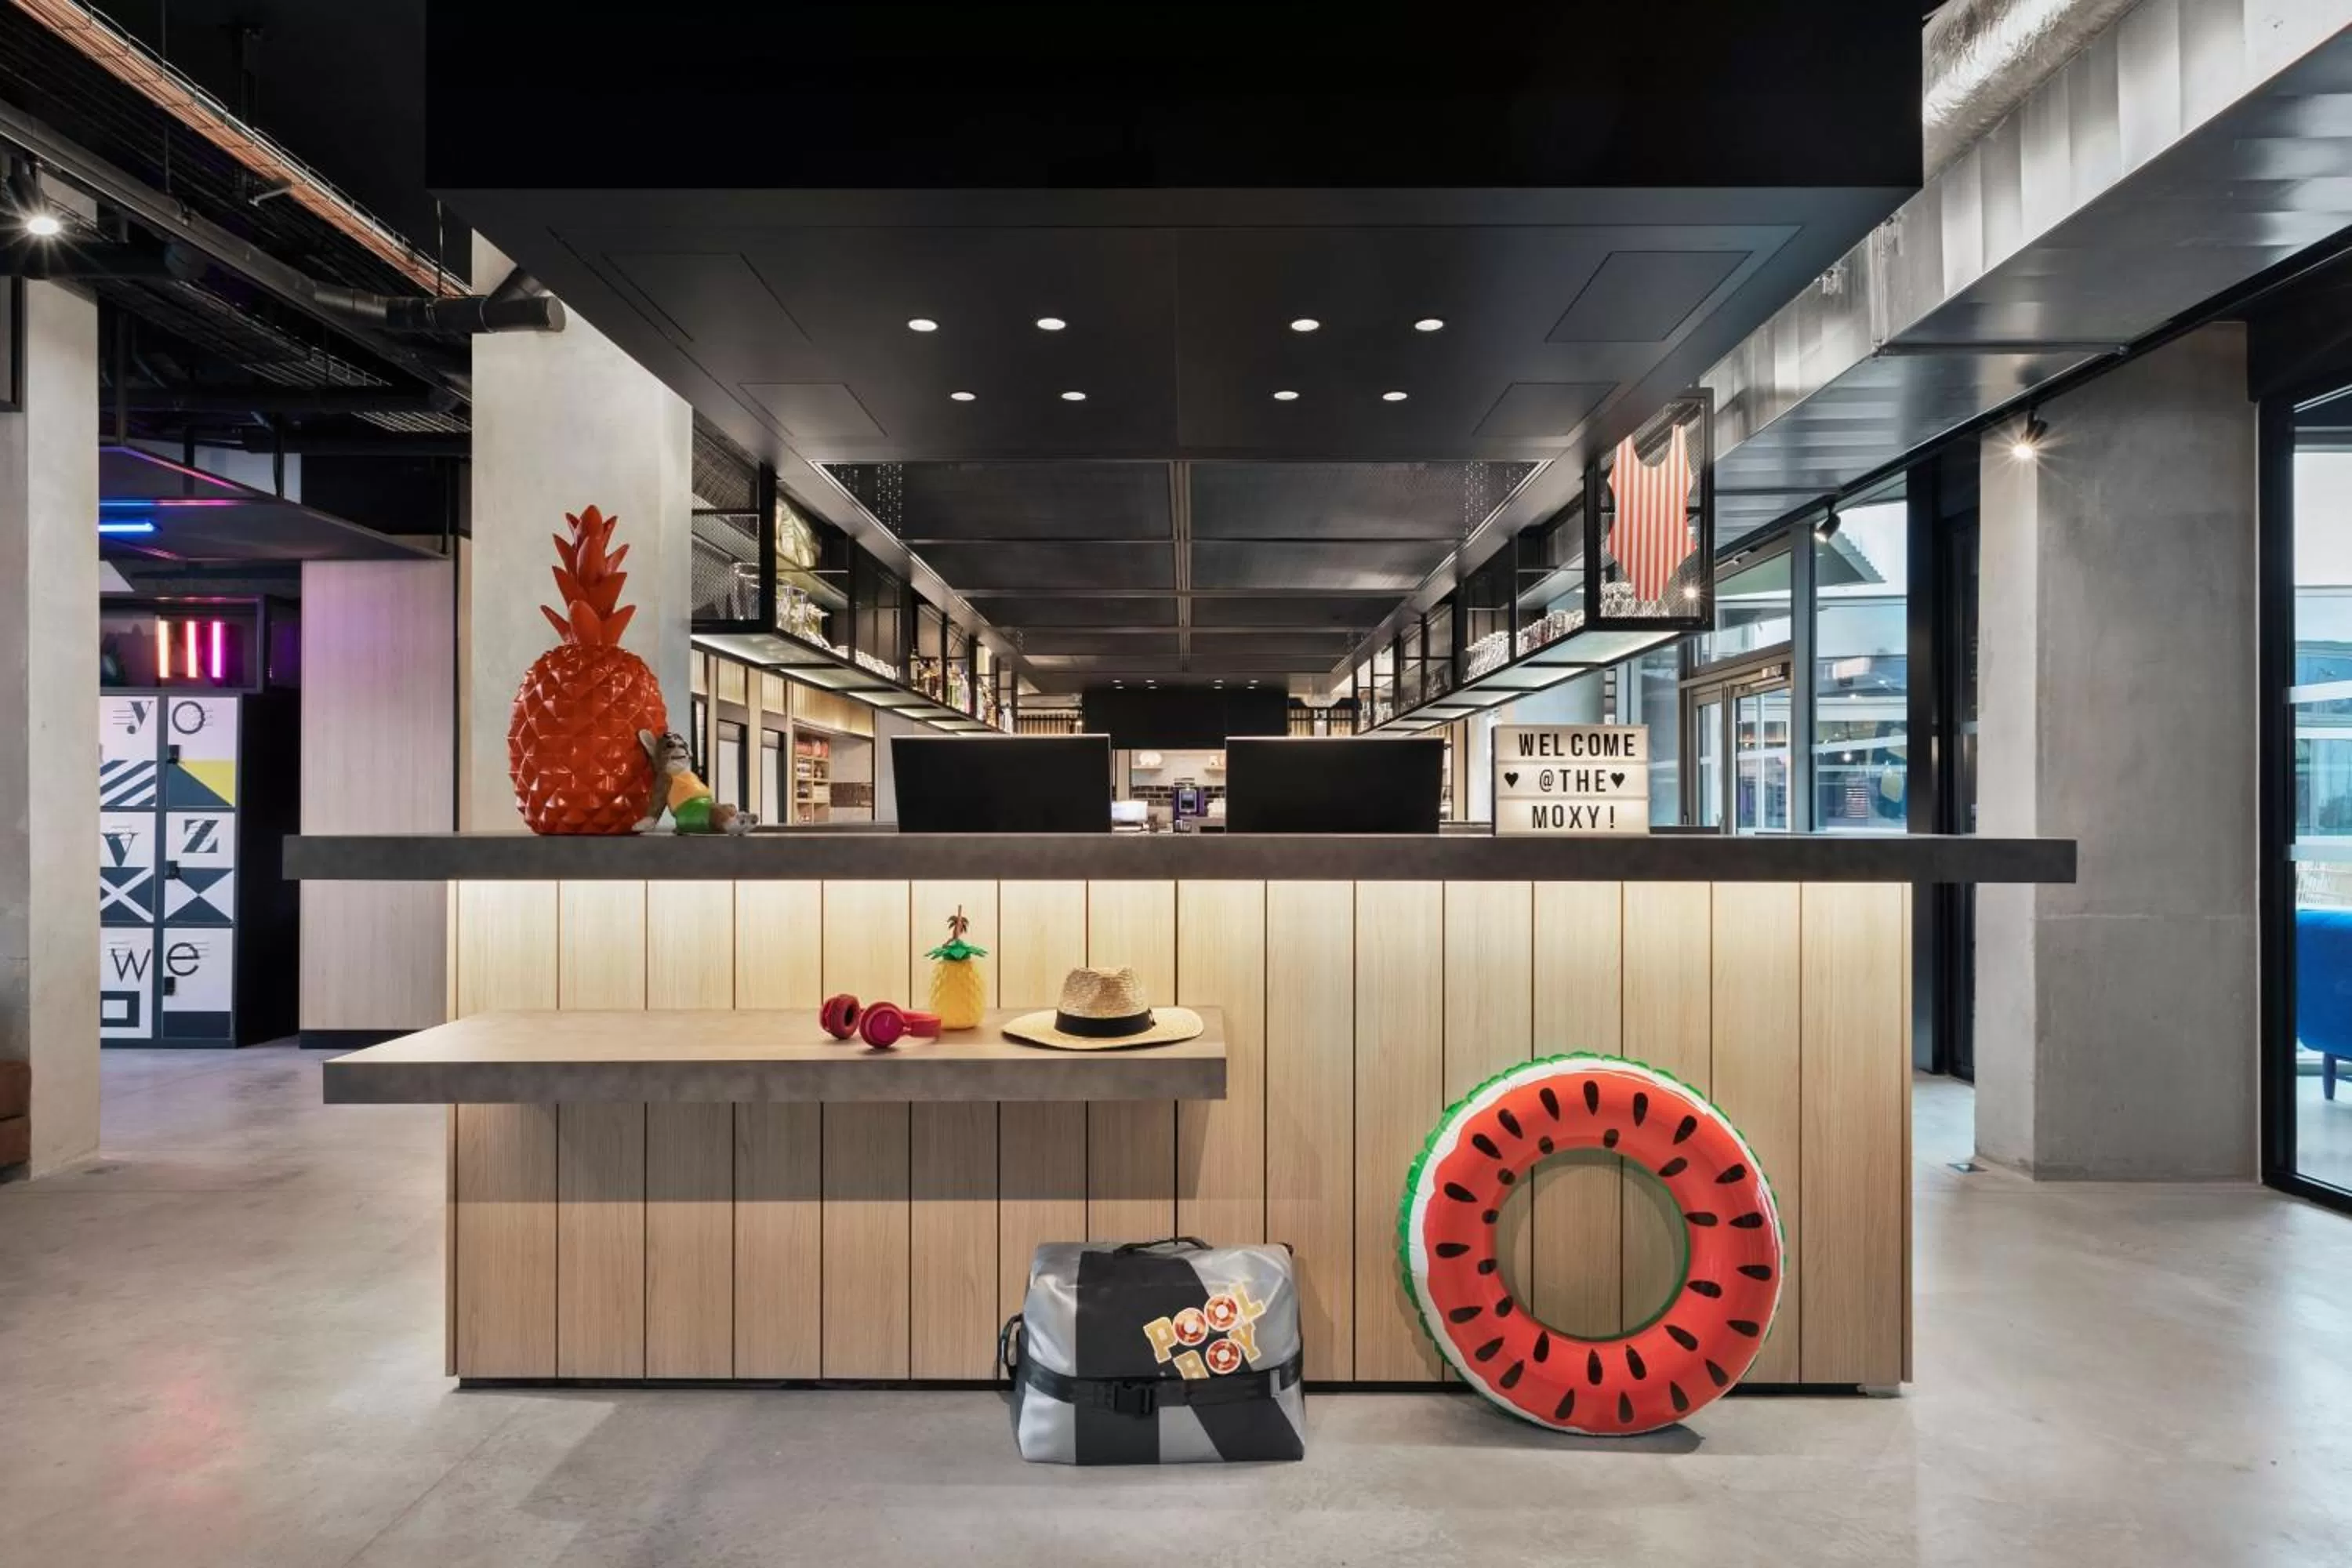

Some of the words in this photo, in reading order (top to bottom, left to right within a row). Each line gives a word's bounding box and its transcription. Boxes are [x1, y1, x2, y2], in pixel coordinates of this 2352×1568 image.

[1518, 733, 1636, 757] WELCOME
[1539, 769, 1606, 793] @THE
[1143, 1283, 1266, 1363] POOL
